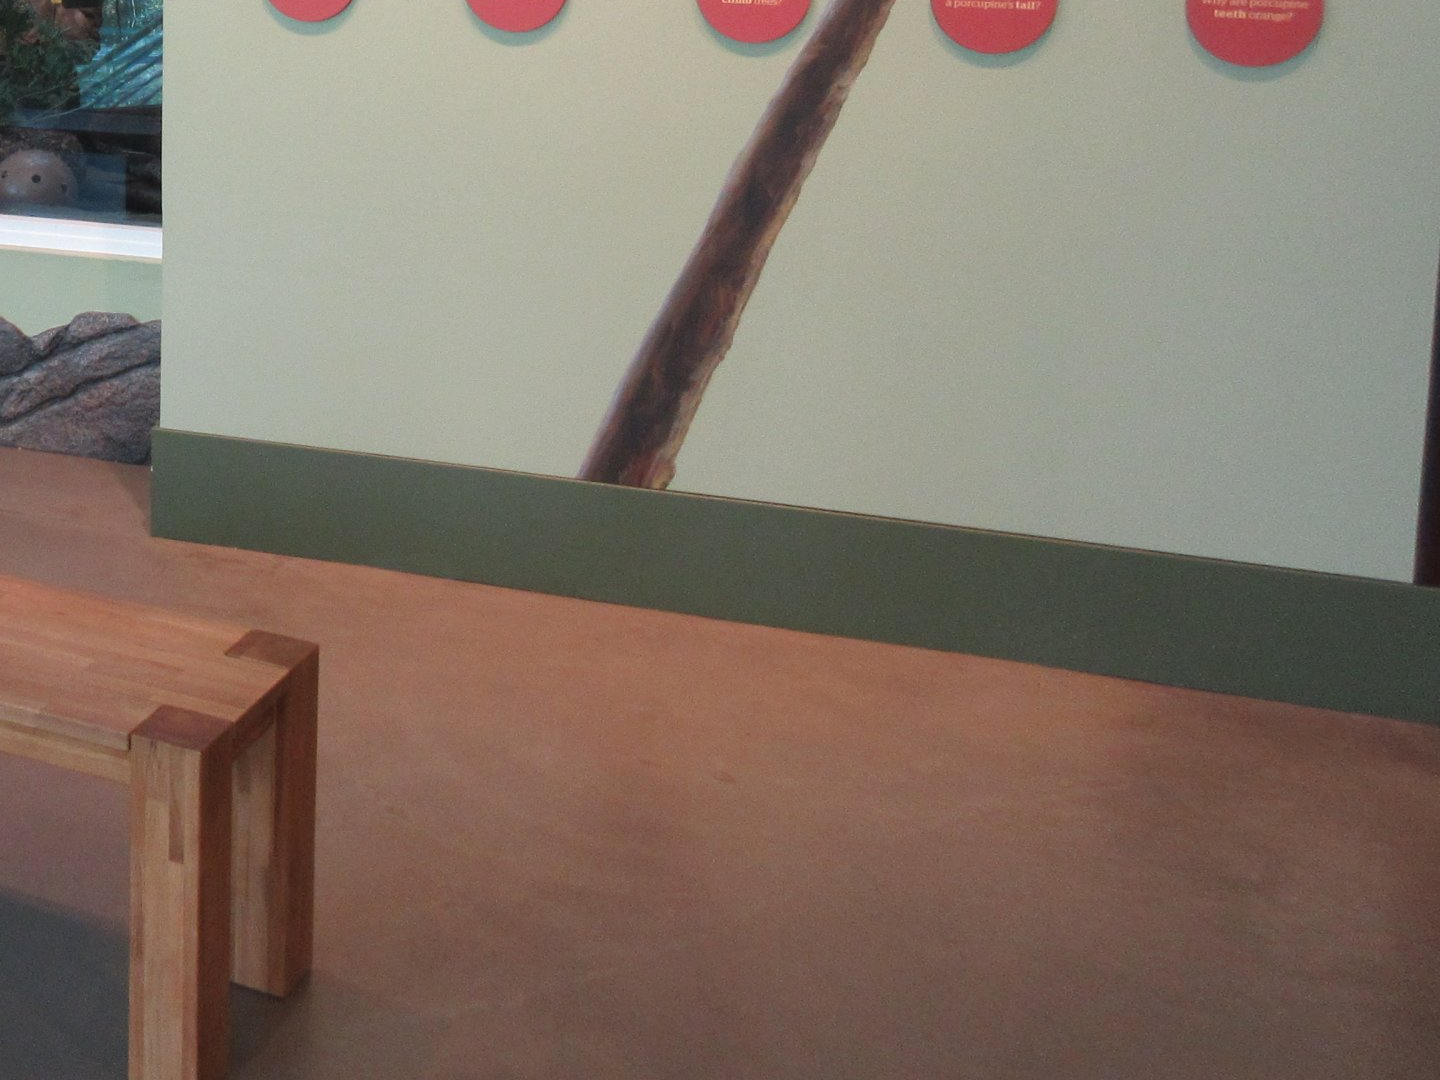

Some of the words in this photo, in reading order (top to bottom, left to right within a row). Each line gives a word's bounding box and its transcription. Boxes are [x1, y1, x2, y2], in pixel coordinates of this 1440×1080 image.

[945, 0, 952, 7] a
[1015, 0, 1041, 11] tail?
[1249, 0, 1308, 9] porcupine
[1213, 9, 1247, 19] teeth
